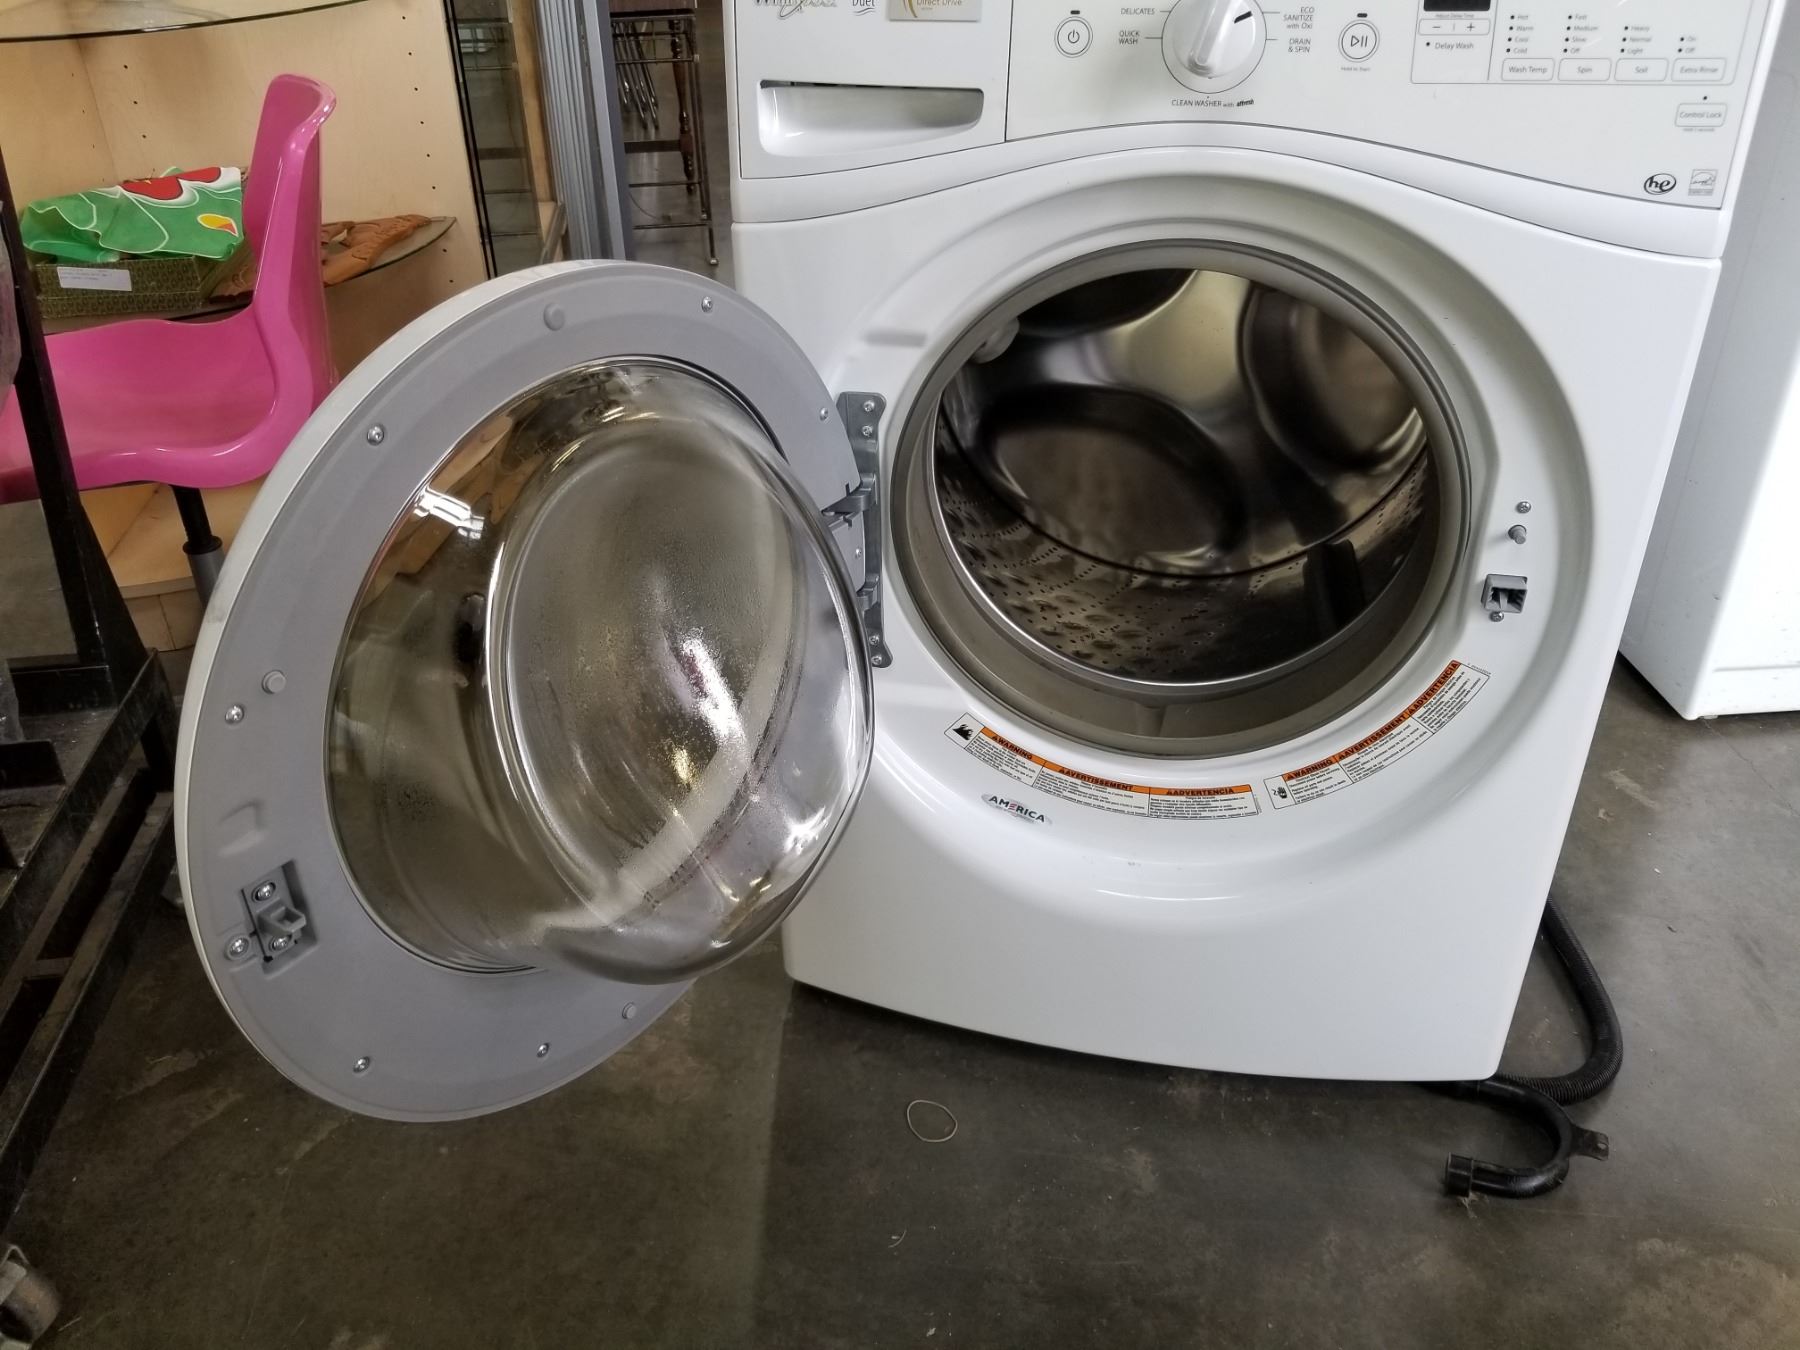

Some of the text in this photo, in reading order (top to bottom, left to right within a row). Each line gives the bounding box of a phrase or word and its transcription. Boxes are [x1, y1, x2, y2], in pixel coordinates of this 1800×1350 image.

[1120, 7, 1156, 15] DELICATES
[1300, 6, 1315, 14] ECO
[1283, 14, 1313, 22] SANITIZE
[1119, 30, 1140, 38] QUICK
[1434, 42, 1454, 51] Delay
[1528, 66, 1548, 74] Temp
[1577, 66, 1592, 74] Spin
[1195, 99, 1222, 107] WASHER
[1647, 174, 1671, 193] he
[1412, 661, 1459, 710] ADVERTENCIA
[1342, 713, 1405, 758] AVERTISSEMENT
[996, 737, 1033, 760] WARNING
[1294, 759, 1333, 778] WARNING
[1064, 769, 1134, 791] AVERTISSEMENT
[1173, 787, 1234, 796] ADVERTENCIA
[988, 796, 1045, 822] AMERICA
